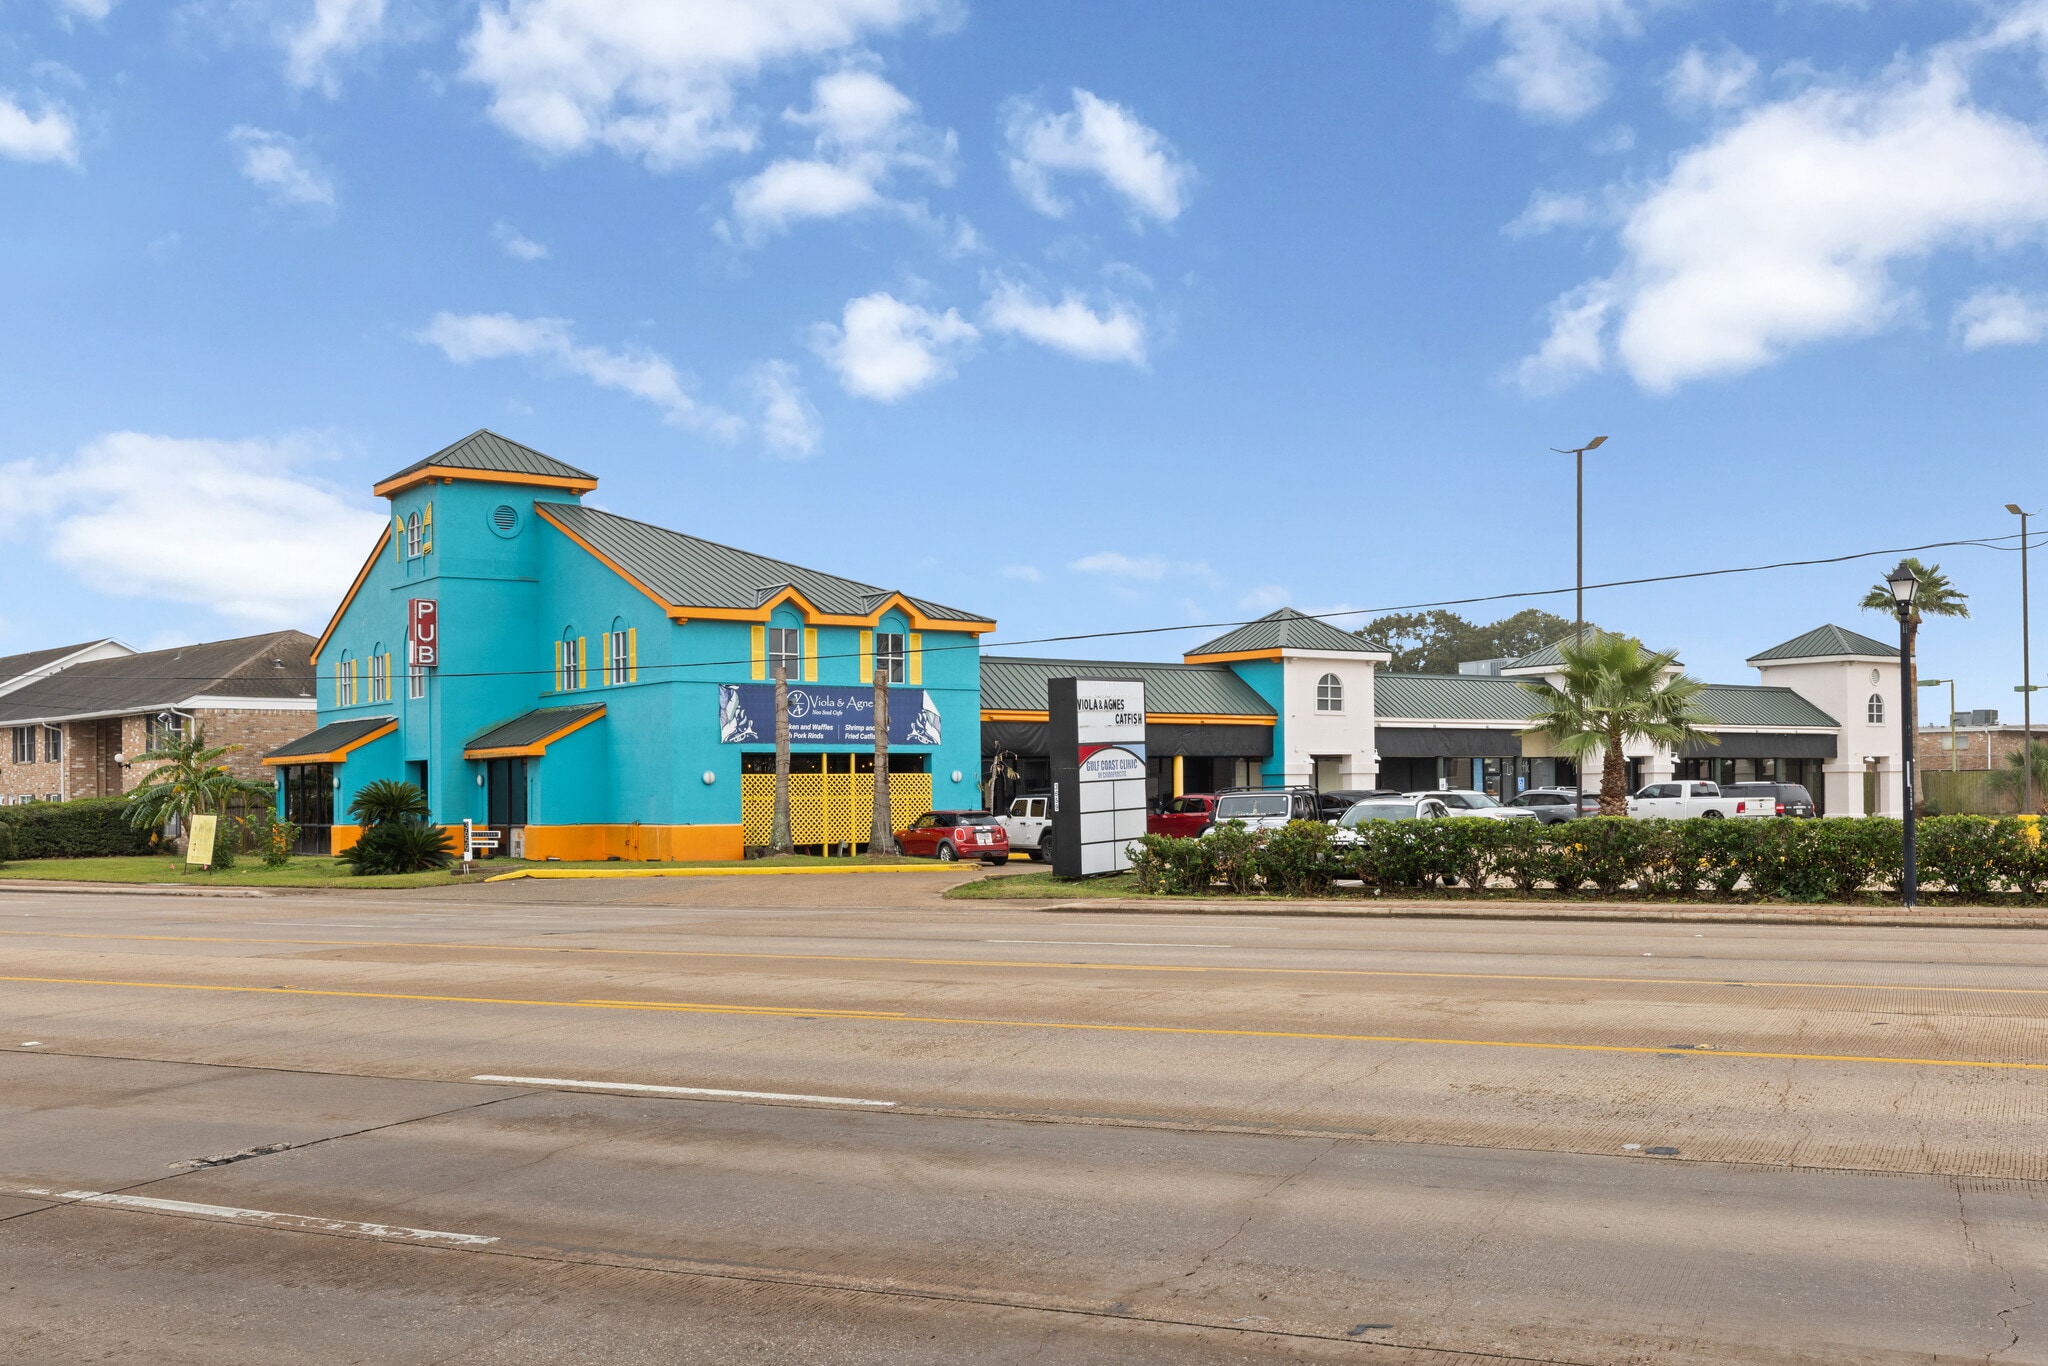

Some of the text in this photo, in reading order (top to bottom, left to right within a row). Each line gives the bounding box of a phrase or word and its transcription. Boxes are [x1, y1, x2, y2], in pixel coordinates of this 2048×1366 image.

[417, 601, 435, 663] PUB
[809, 695, 874, 711] Viola & Agne
[1077, 698, 1098, 711] VIOLA
[1103, 698, 1125, 711] AGNES
[1115, 713, 1143, 725] CATFISH
[800, 723, 811, 731] and
[812, 723, 834, 731] Waffles
[844, 724, 865, 732] Shrimp
[844, 732, 876, 740] Fried Catfis
[1086, 758, 1138, 772] GULF COAST CLINIC
